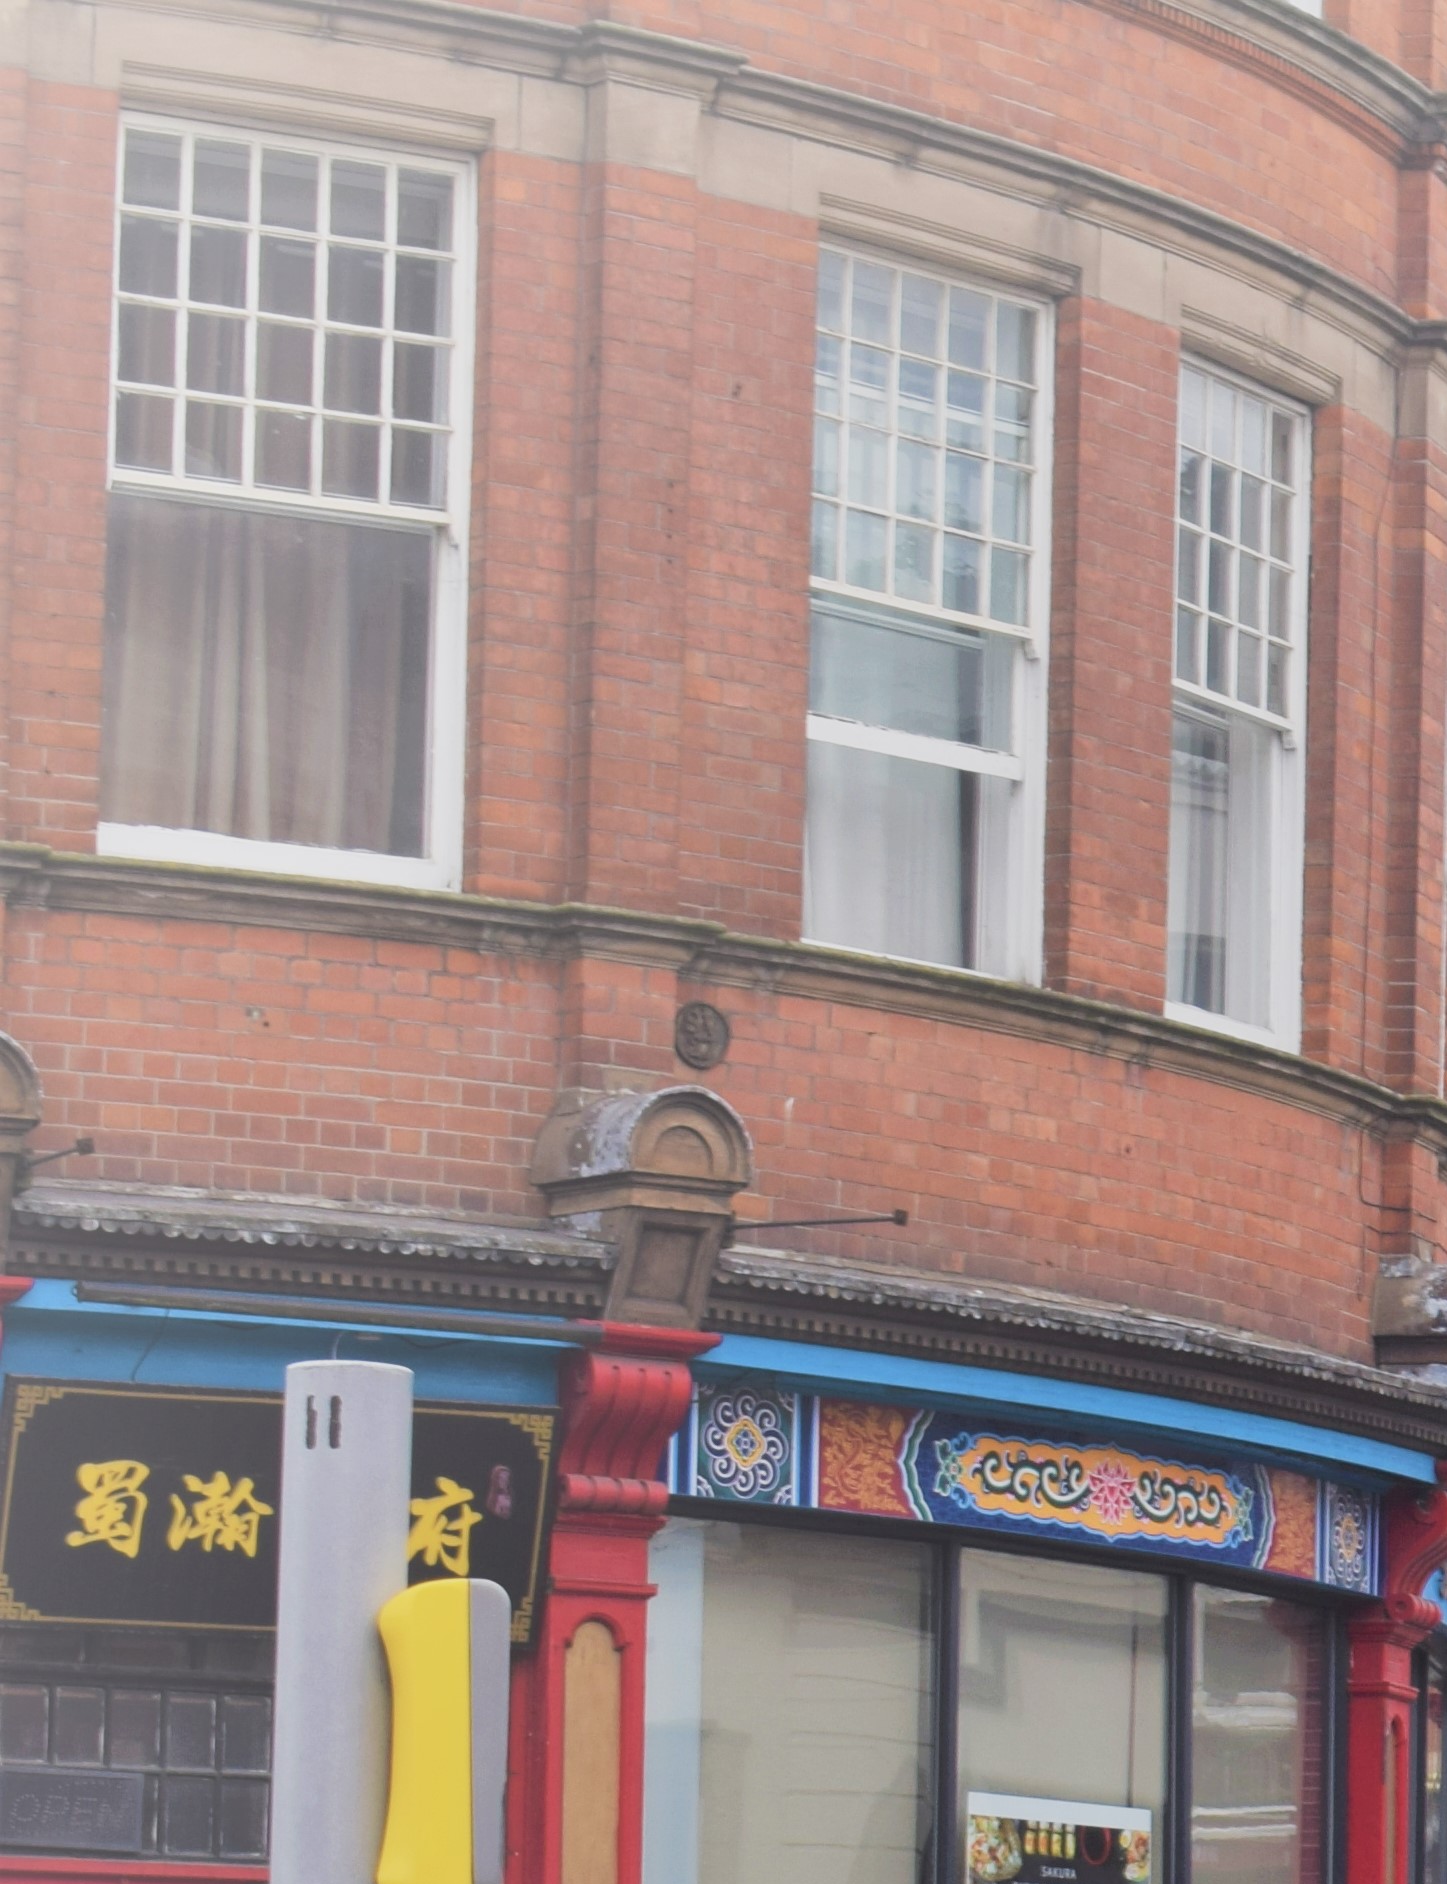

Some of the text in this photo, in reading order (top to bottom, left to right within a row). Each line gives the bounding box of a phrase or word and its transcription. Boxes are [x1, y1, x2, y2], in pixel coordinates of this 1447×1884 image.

[65, 1459, 483, 1577] 蜀瀚府
[1041, 1866, 1077, 1879] SAKURA
